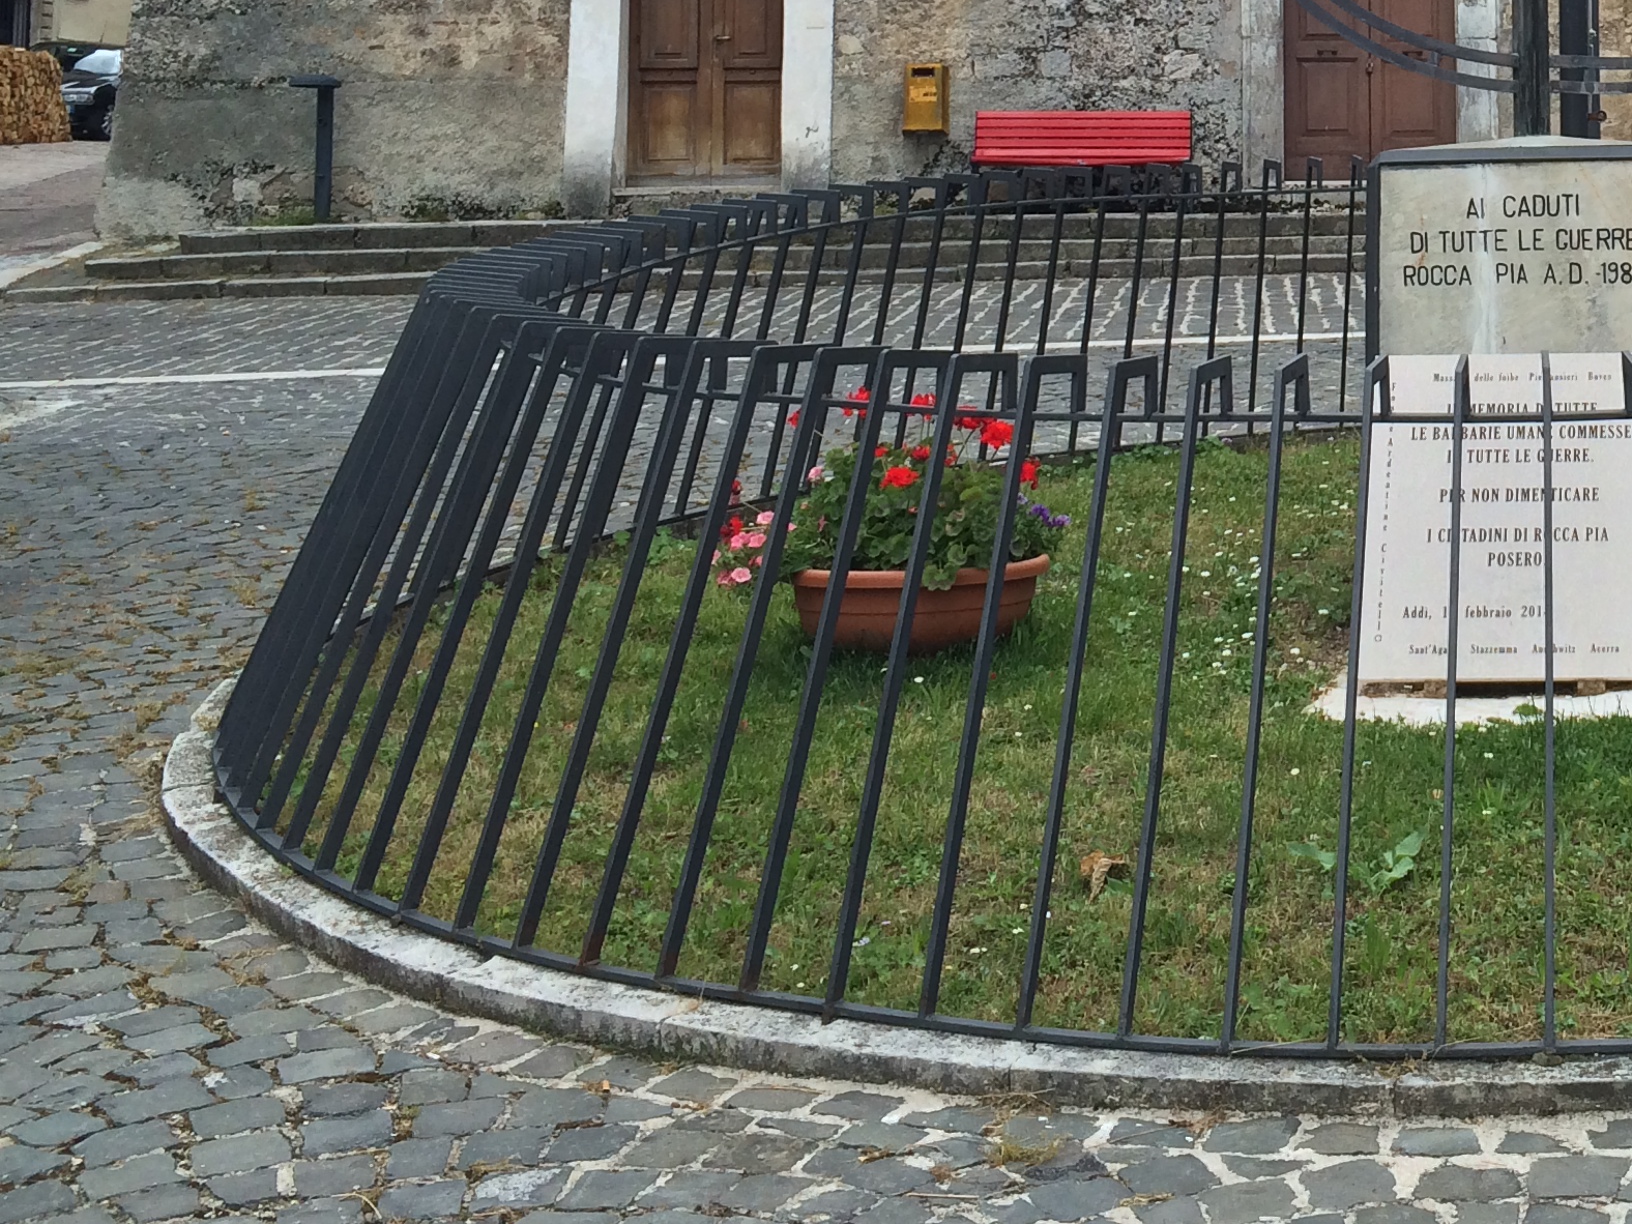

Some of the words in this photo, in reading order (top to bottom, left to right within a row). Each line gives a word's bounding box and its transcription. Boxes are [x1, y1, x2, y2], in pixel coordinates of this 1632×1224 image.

[1466, 197, 1485, 219] AI
[1502, 193, 1580, 218] CADUTI
[1410, 231, 1429, 254] DI
[1438, 229, 1508, 254] TUTTE
[1518, 228, 1545, 251] LE
[1403, 265, 1472, 287] ROCCA
[1495, 262, 1528, 285] PIA
[1474, 372, 1494, 382] delle
[1554, 402, 1598, 412] TUTTE
[1411, 427, 1428, 440] LE
[1507, 424, 1553, 439] UMAN
[1559, 424, 1632, 439] COMMESSE
[1466, 448, 1510, 463] TUTTE
[1515, 448, 1531, 463] LE
[1471, 487, 1500, 502] NON
[1427, 528, 1432, 543] I
[1437, 527, 1508, 543] CITADINI
[1513, 527, 1528, 542] DI
[1533, 526, 1580, 542] RCCA
[1585, 526, 1610, 542] PIA
[1465, 605, 1512, 619] febbraio
[1520, 605, 1547, 618] 201
[1590, 643, 1620, 654] Acerra
